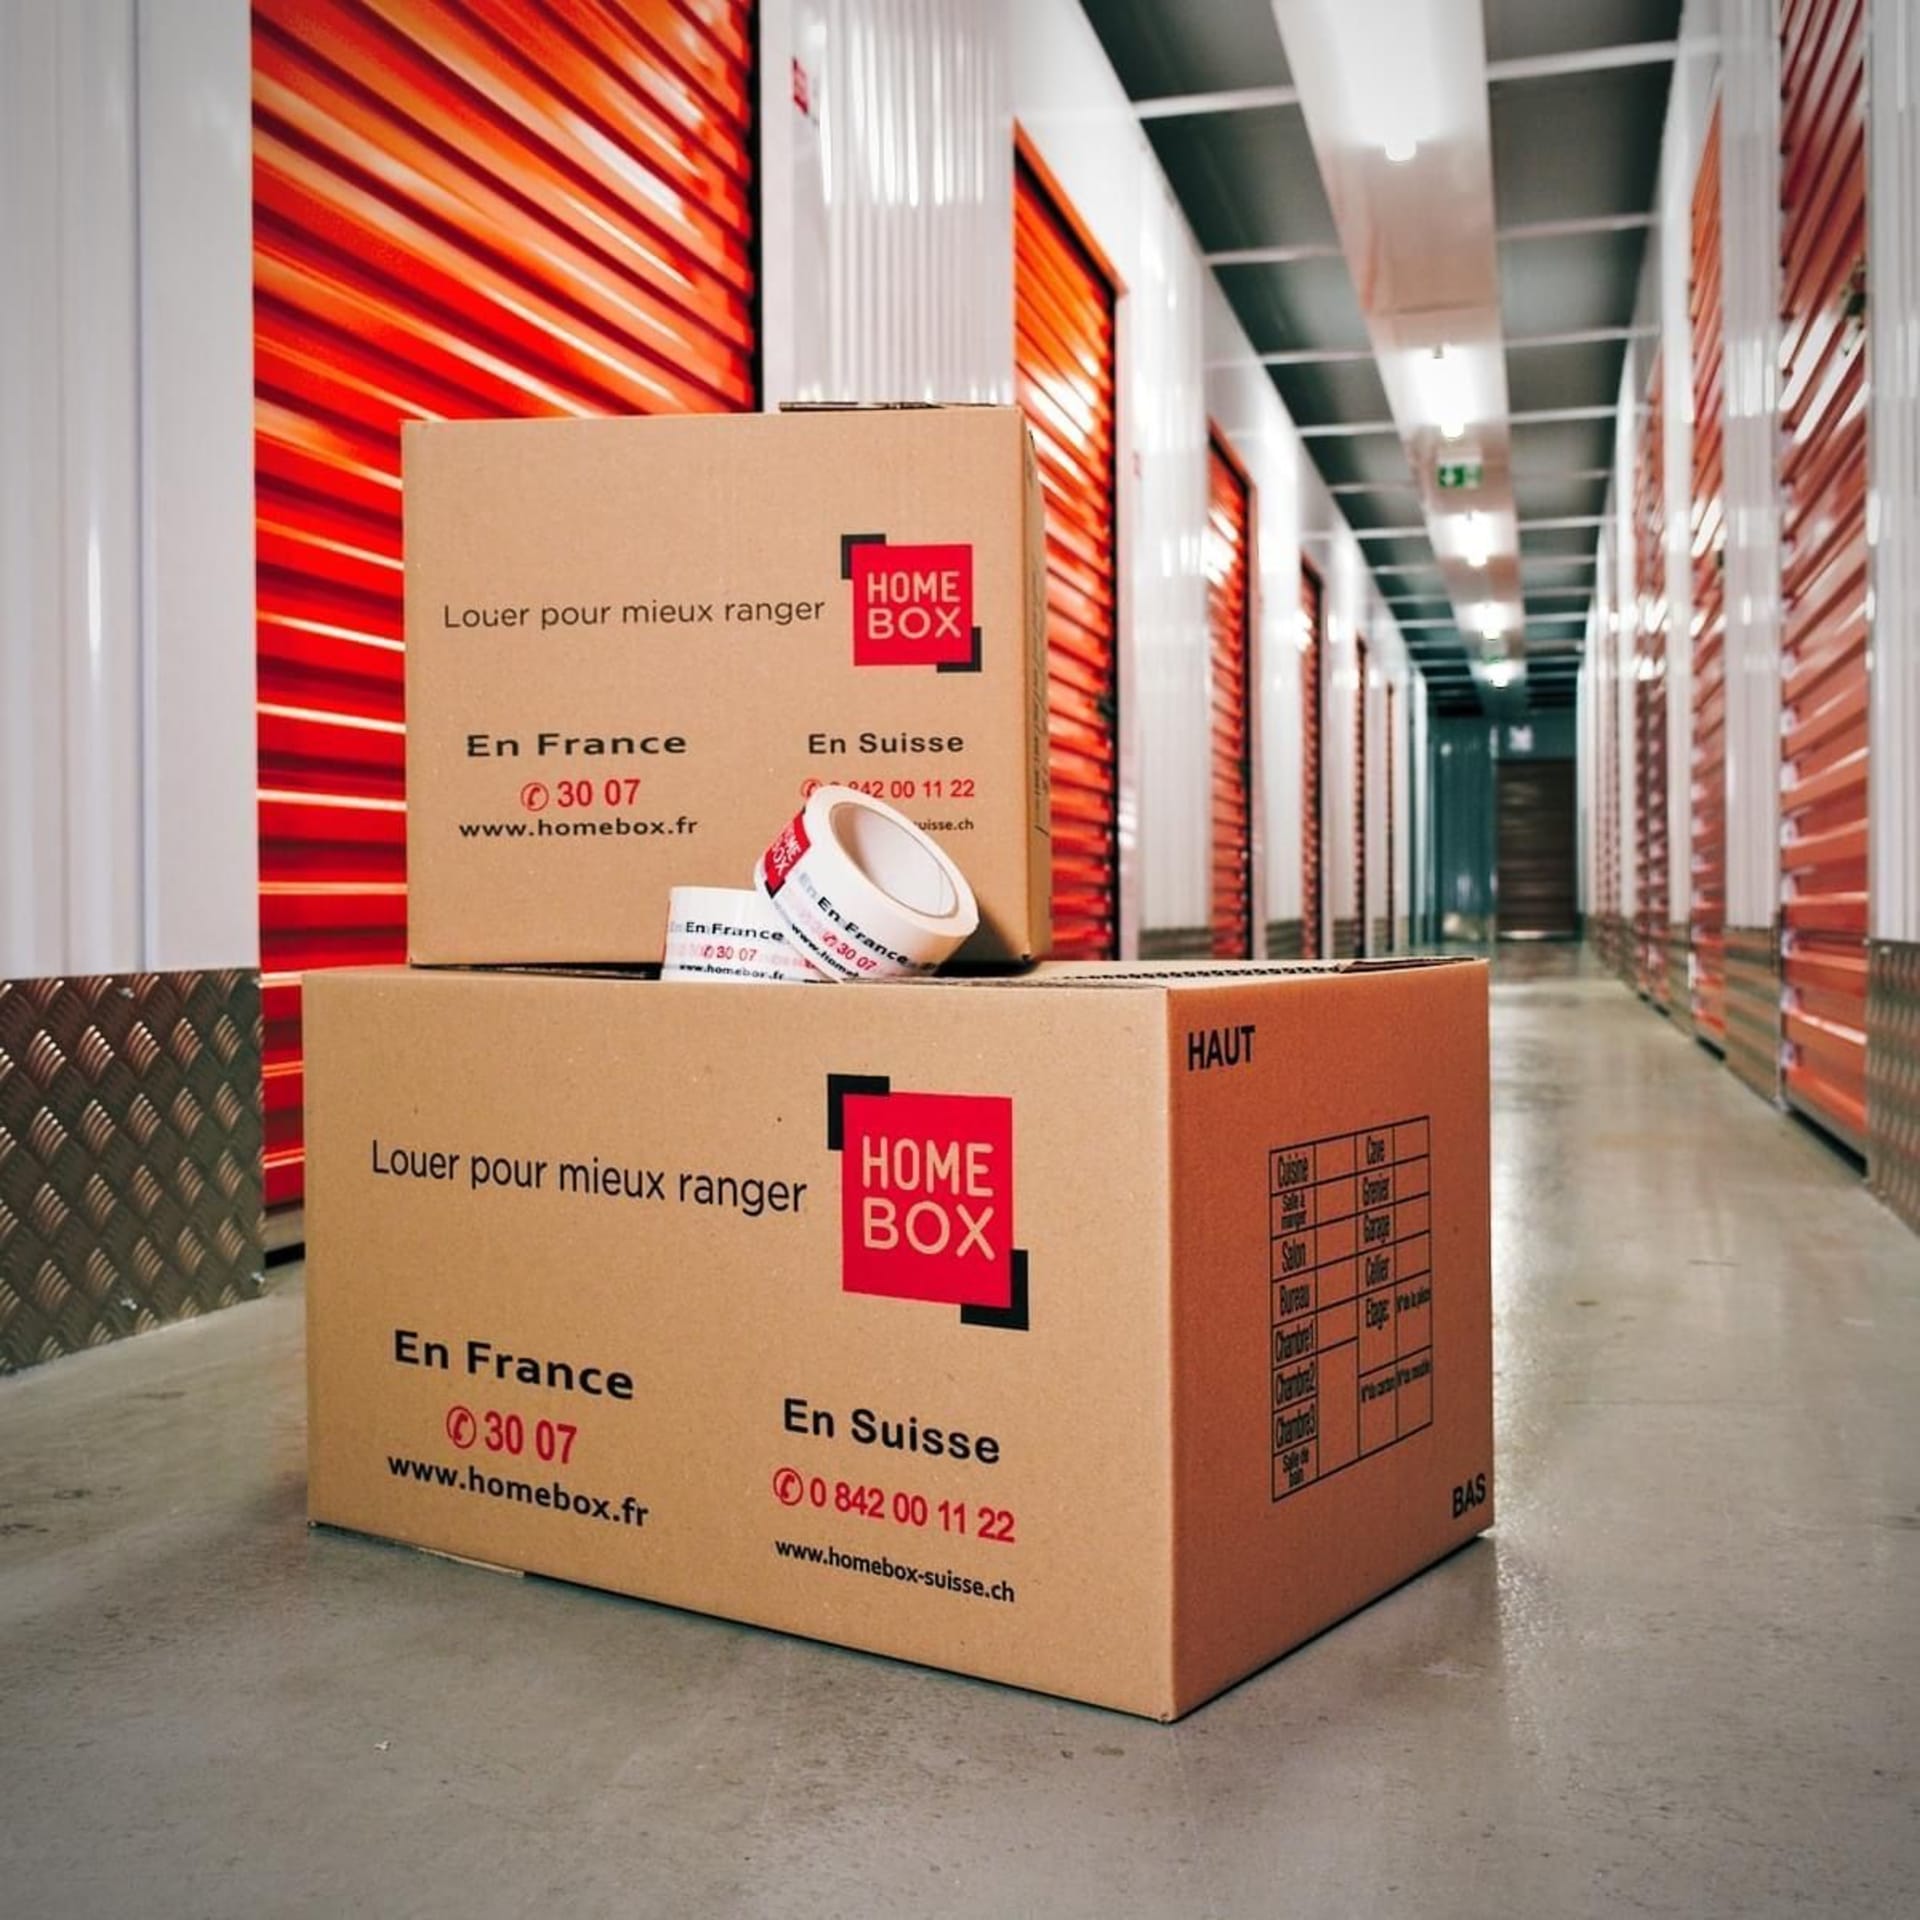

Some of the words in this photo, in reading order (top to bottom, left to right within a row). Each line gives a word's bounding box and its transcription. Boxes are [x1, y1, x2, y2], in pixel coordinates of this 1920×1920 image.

[867, 571, 961, 604] HOME
[444, 602, 530, 629] Louer
[541, 605, 612, 631] pour
[622, 599, 713, 624] mieux
[724, 601, 825, 626] ranger
[867, 606, 961, 640] BOX
[466, 735, 520, 758] En
[537, 732, 687, 757] France
[808, 733, 847, 755] En
[859, 732, 964, 754] Suisse
[557, 780, 594, 808] 30
[604, 778, 641, 807] 07
[890, 780, 916, 799] 00
[923, 780, 943, 798] 11
[950, 779, 975, 798] 22
[458, 815, 698, 838] www.homebox.fr
[685, 921, 706, 934] En
[711, 922, 784, 942] France
[817, 896, 841, 923] En
[844, 921, 909, 964] France
[738, 948, 758, 962] 07
[836, 942, 857, 962] 30
[856, 956, 877, 972] 07
[1187, 1025, 1256, 1072] HAUT
[862, 1135, 994, 1198] HOME
[1366, 1135, 1385, 1165] Cave
[372, 1140, 461, 1181] Louer
[470, 1155, 549, 1191] pour
[559, 1156, 666, 1201] mieux
[679, 1173, 808, 1218] ranger
[1277, 1153, 1309, 1188] Cuisine
[862, 1200, 996, 1261] BOX
[1363, 1210, 1390, 1244] Garage
[1282, 1238, 1306, 1273] Salon
[1279, 1284, 1310, 1317] Bureau
[394, 1330, 449, 1371] En
[467, 1339, 634, 1401] France
[483, 1411, 526, 1456] 30
[535, 1419, 578, 1465] 07
[783, 1398, 835, 1439] En
[850, 1408, 1000, 1464] Suisse
[388, 1452, 649, 1527] www.homebox.fr
[1451, 1473, 1487, 1520] BAS
[809, 1476, 829, 1508] 0
[835, 1481, 885, 1520] 842
[892, 1491, 929, 1527] 00
[937, 1499, 966, 1535] 11
[977, 1506, 1016, 1544] 22
[774, 1538, 1016, 1603] www.homebox-suisse.ch
